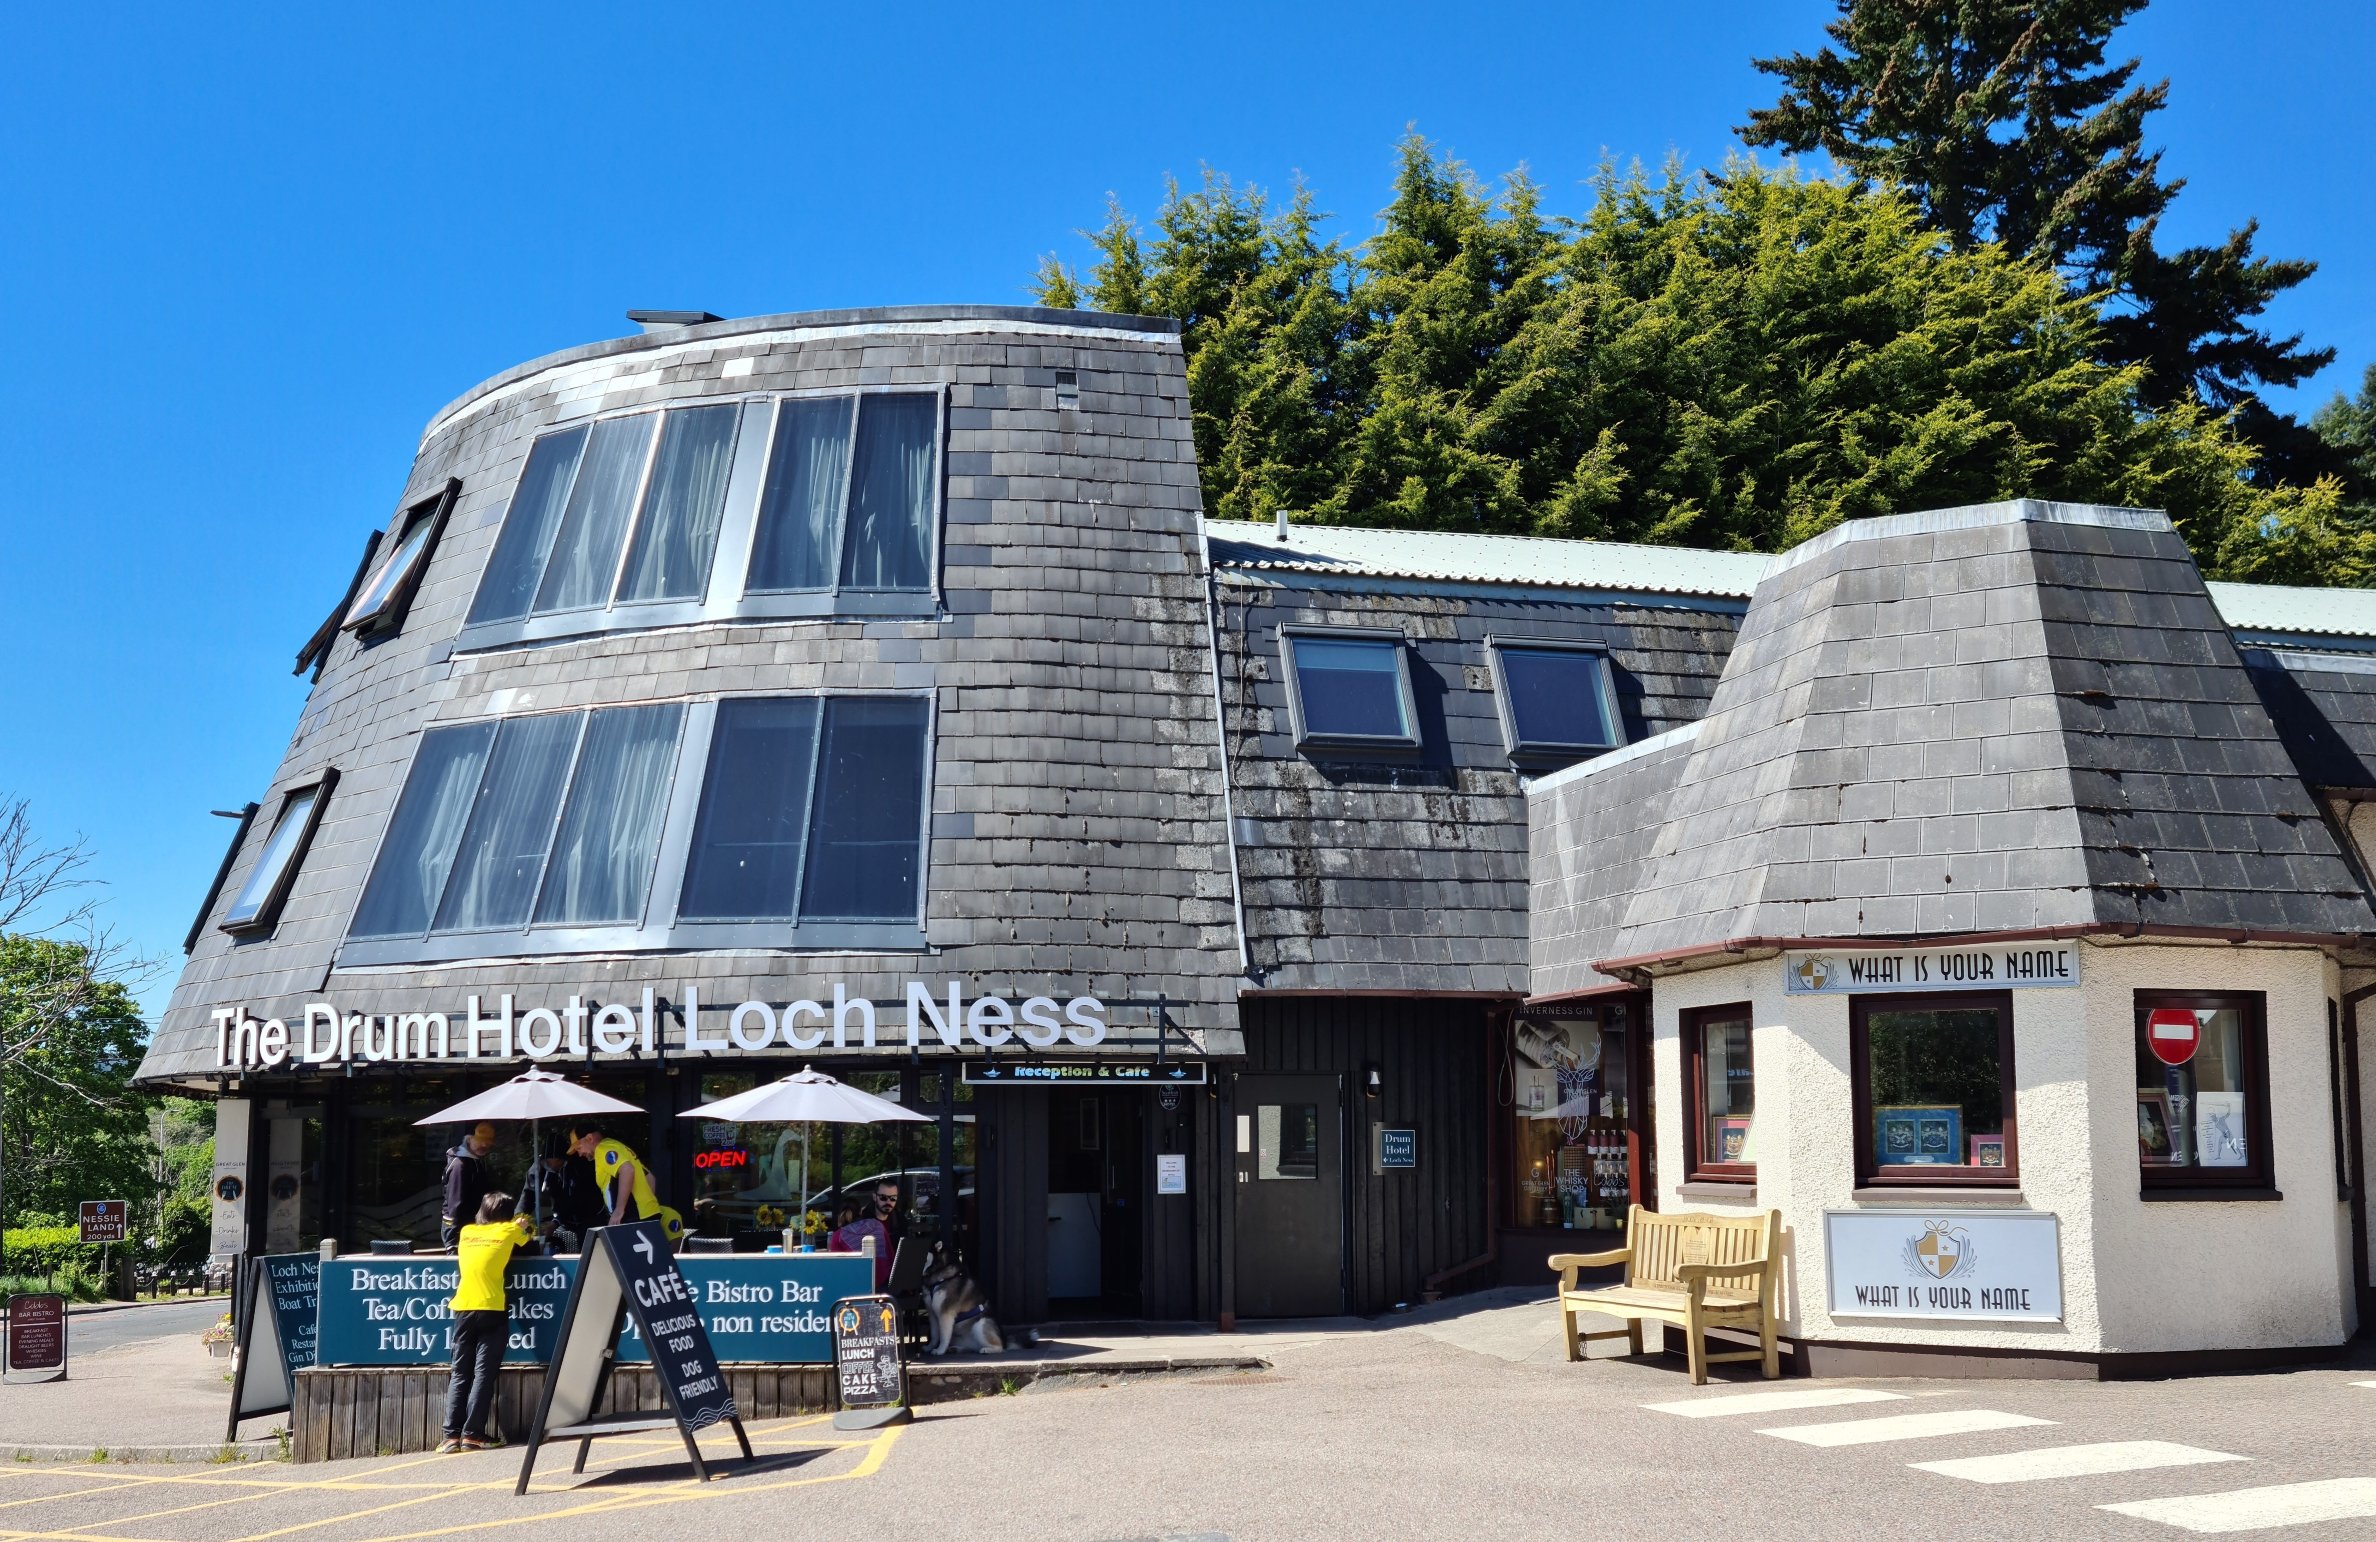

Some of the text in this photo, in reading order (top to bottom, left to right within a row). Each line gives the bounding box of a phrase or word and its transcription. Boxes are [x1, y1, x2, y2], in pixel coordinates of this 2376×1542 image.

[1848, 950, 2069, 984] WHAT IS YOUR NAME
[1520, 1006, 1593, 1015] INVERNESS GIN
[211, 981, 1106, 1067] The Drum Hotel Loch Ness
[1015, 1066, 1092, 1079] Reception
[1098, 1067, 1110, 1077] &
[1385, 1133, 1410, 1142] Drum
[1386, 1145, 1410, 1154] Hotel
[695, 1151, 747, 1168] OPEN
[1563, 1168, 1580, 1176] THE
[1560, 1185, 1584, 1193] SHOP
[83, 1214, 120, 1223] NESSIE
[87, 1223, 115, 1231] LAND
[271, 1263, 298, 1278] Loch
[350, 1267, 459, 1291] Breakfast
[634, 1265, 687, 1308] CAFÉ
[706, 1280, 773, 1303] Bistro
[781, 1280, 823, 1303] Bar
[1855, 1285, 2031, 1311] WHAT IS YOUR NAME
[278, 1295, 317, 1310] Boat Tr
[508, 1296, 554, 1320] akes
[651, 1314, 697, 1337] DELICIOUS
[711, 1316, 754, 1333] non
[378, 1327, 436, 1356] Fully
[668, 1335, 695, 1353] FOOD
[841, 1335, 895, 1349] BREAKFASTS
[288, 1352, 304, 1363] Gin
[842, 1348, 875, 1360] LUNCH
[681, 1360, 703, 1378] DOG
[842, 1360, 875, 1375] COFFEE
[842, 1373, 877, 1386] CAKE
[679, 1375, 719, 1400] FRIENDLY
[843, 1385, 878, 1396] PIZZA
